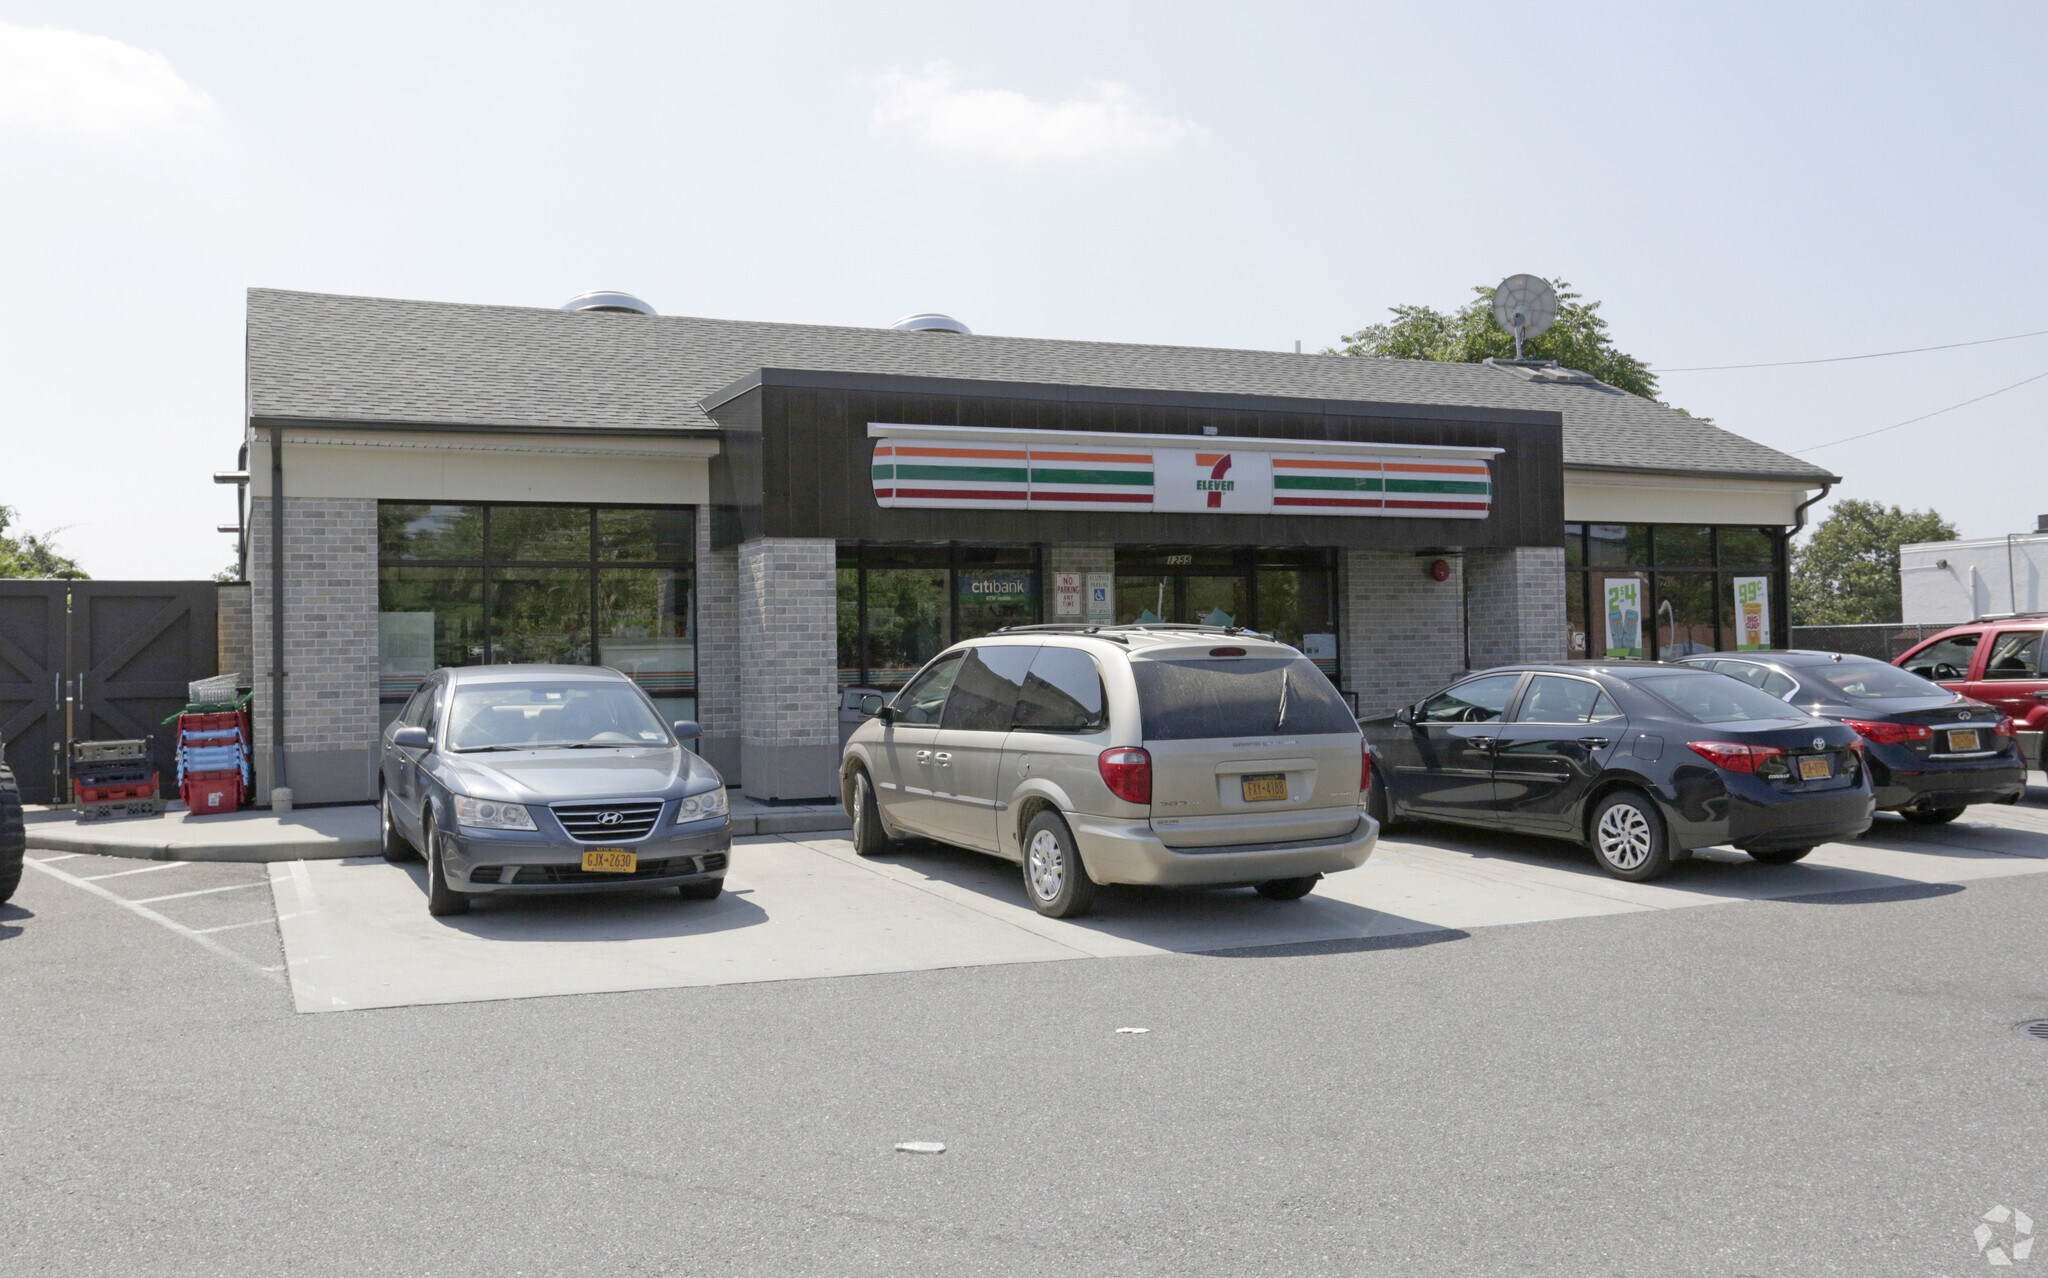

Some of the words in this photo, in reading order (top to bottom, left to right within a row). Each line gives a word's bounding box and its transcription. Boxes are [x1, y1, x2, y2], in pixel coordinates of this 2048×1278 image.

[1195, 453, 1232, 508] 7
[971, 579, 1025, 593] citibank
[1063, 576, 1073, 585] NO
[1057, 585, 1080, 594] PARKING
